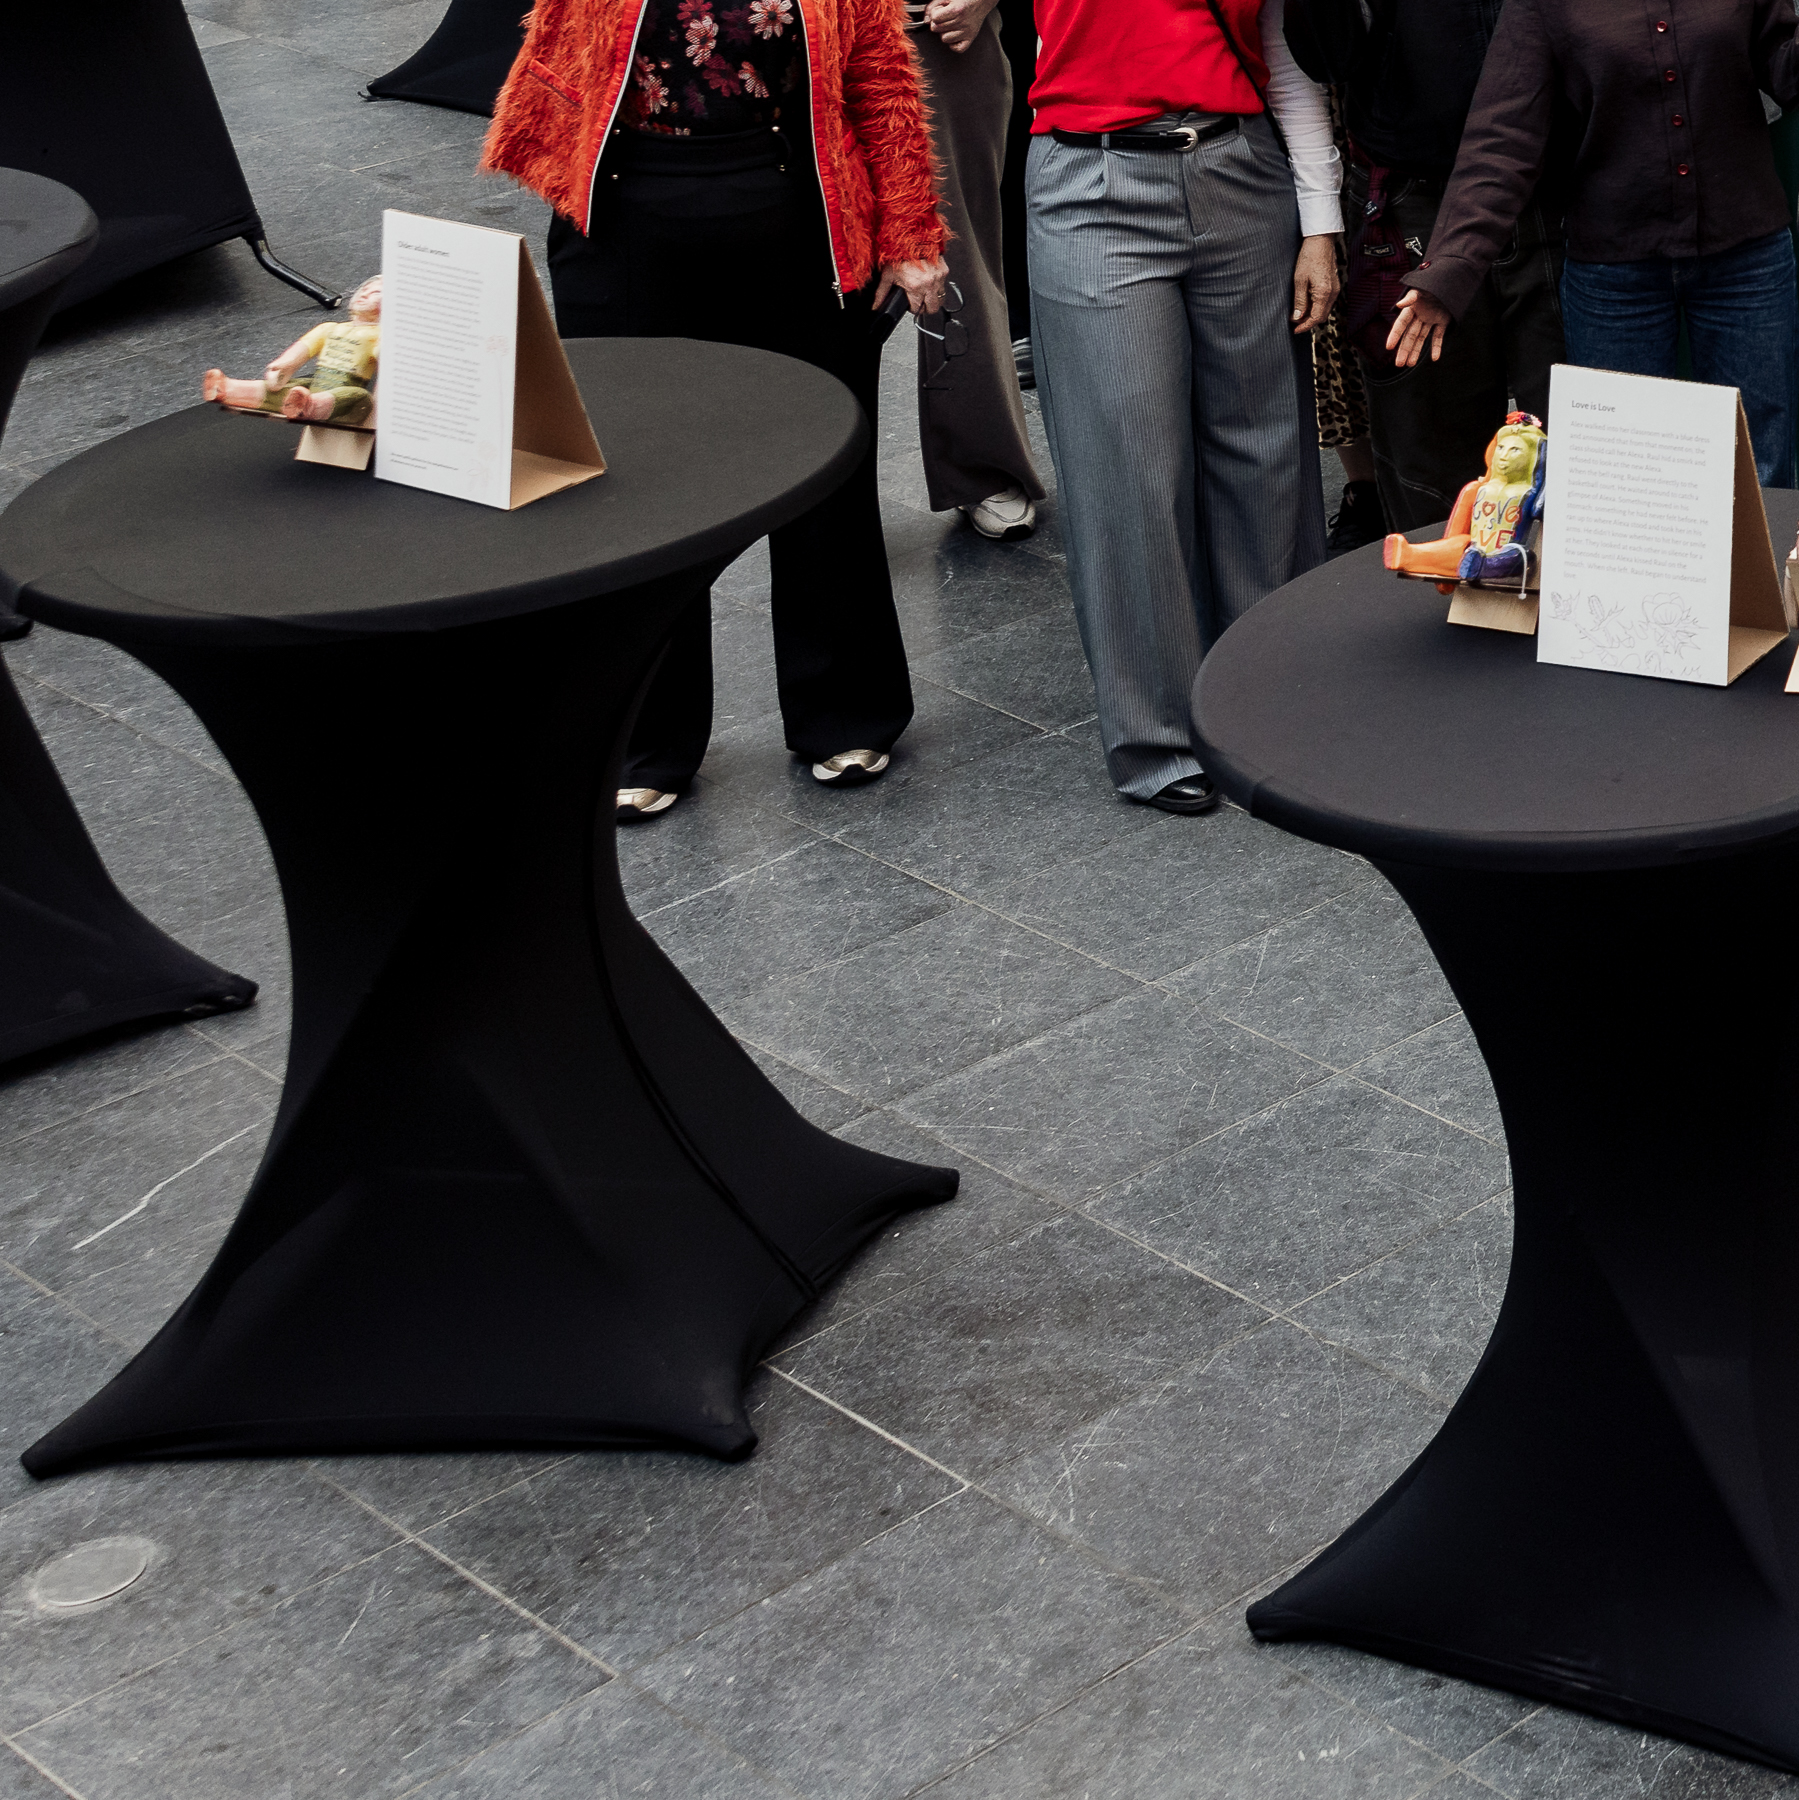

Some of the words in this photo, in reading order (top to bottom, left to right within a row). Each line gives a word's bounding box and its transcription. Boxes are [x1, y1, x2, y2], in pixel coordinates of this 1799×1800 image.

[1571, 400, 1589, 409] Love
[1590, 402, 1597, 410] is
[1598, 403, 1616, 412] Love
